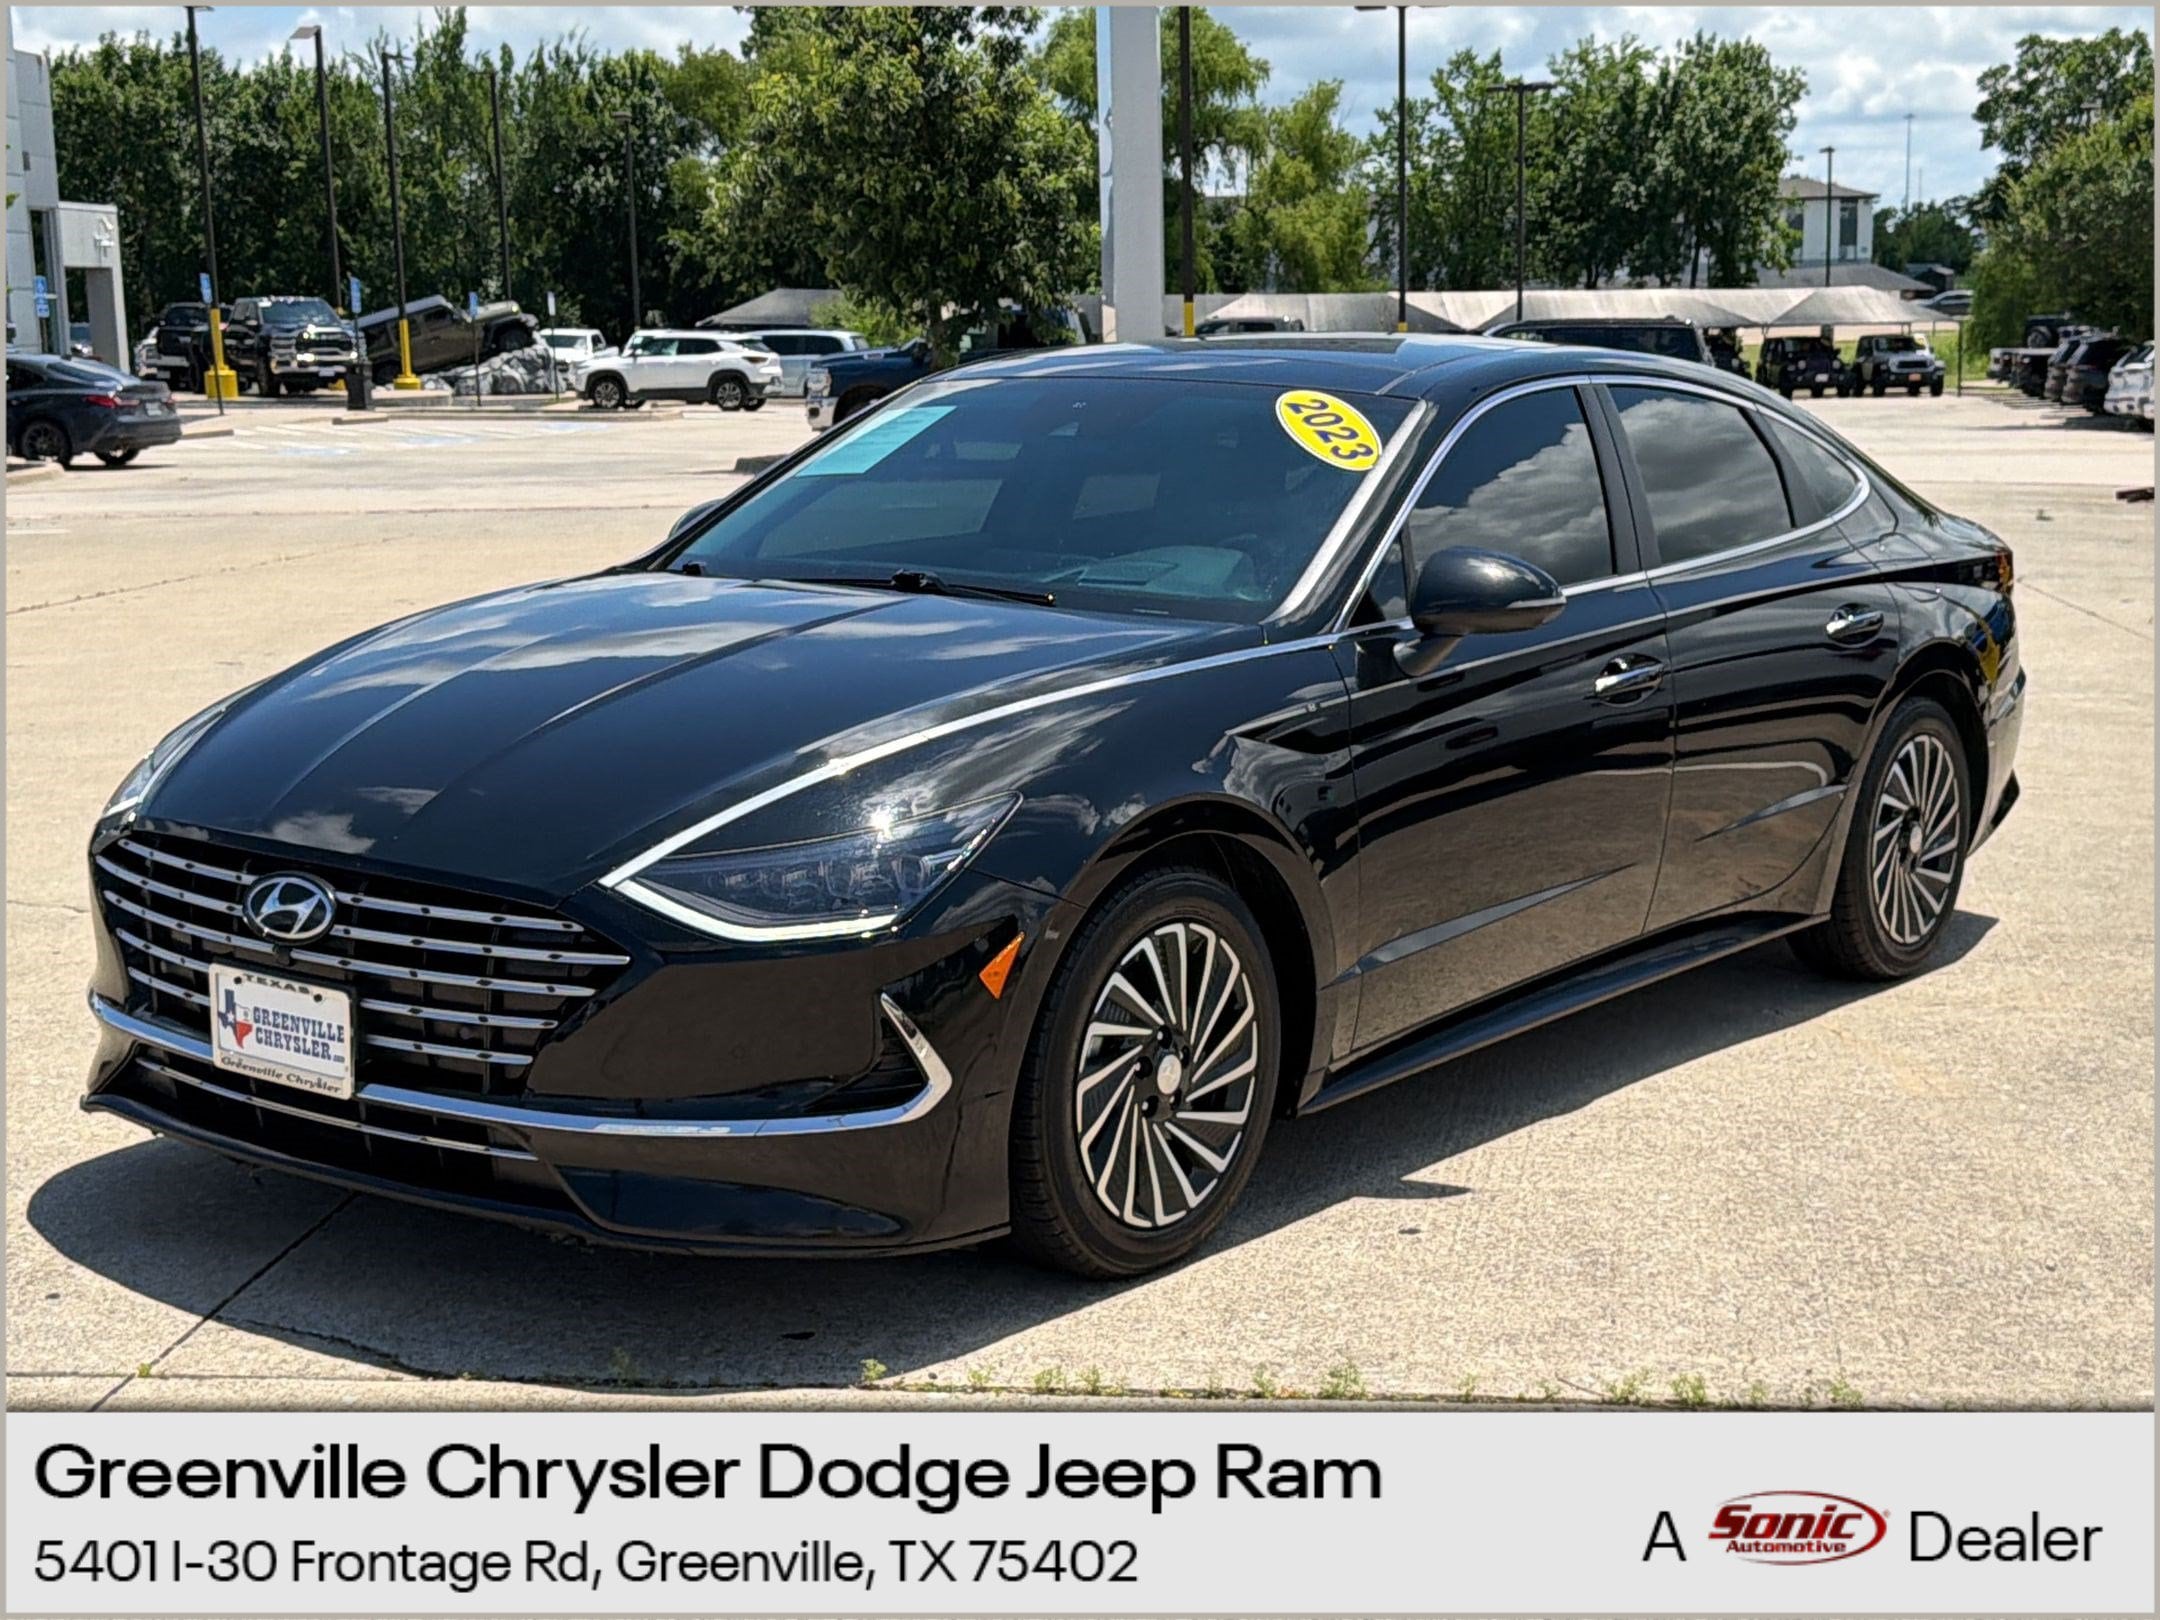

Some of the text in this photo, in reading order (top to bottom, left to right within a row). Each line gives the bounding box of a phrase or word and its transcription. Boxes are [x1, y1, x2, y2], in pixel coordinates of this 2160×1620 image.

[1284, 398, 1374, 460] 2023
[243, 973, 311, 995] TEXAS
[253, 1006, 345, 1043] GREENVILLE
[220, 1055, 342, 1094] Greenville Chrysler
